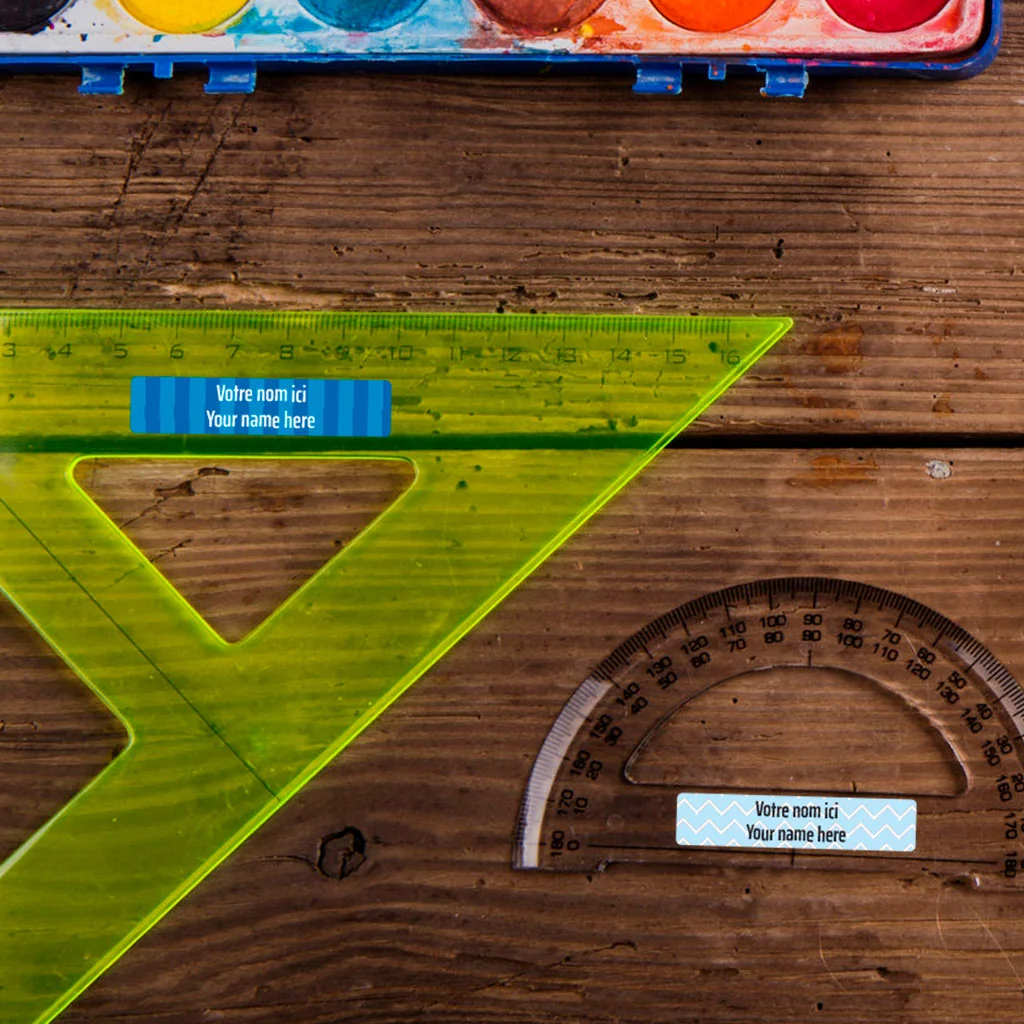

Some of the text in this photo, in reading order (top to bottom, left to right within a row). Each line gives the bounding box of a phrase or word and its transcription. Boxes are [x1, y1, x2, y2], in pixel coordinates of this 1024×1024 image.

[2, 343, 16, 357] 3
[58, 343, 72, 358] 4
[114, 344, 128, 358] 5
[170, 344, 184, 359] 6
[225, 344, 240, 359] 7
[279, 345, 293, 360] 8
[501, 347, 522, 362] 12
[557, 348, 576, 362] 13
[610, 349, 631, 363] 14
[666, 349, 686, 364] 15
[721, 349, 740, 364] 16
[216, 384, 306, 403] Votre nom ici
[206, 410, 316, 429] Your name here
[719, 621, 747, 638] 110
[759, 614, 787, 628] 100
[803, 614, 822, 626] 90
[843, 618, 863, 632] 80
[681, 635, 709, 654] 120
[727, 638, 746, 653] 70
[764, 631, 784, 644] 80
[837, 632, 863, 649] 100
[882, 628, 901, 645] 70
[873, 643, 899, 661] 110
[917, 647, 936, 664] 60
[646, 656, 672, 677] 130
[906, 659, 931, 681] 120
[658, 671, 678, 689] 50
[948, 670, 967, 689] 50
[616, 682, 640, 706] 140
[936, 681, 959, 704] 130
[631, 696, 648, 714] 40
[976, 703, 993, 720] 40
[961, 708, 983, 733] 140
[981, 740, 1000, 767] 150
[997, 735, 1013, 755] 30
[996, 775, 1012, 802] 160
[557, 788, 574, 815] 170
[573, 797, 588, 814] 10
[755, 800, 839, 819] Votre nom ici
[746, 824, 846, 843] Your name here
[1005, 813, 1017, 840] 170
[550, 830, 565, 857] 180
[567, 840, 579, 851] 0
[1004, 851, 1017, 878] 180
